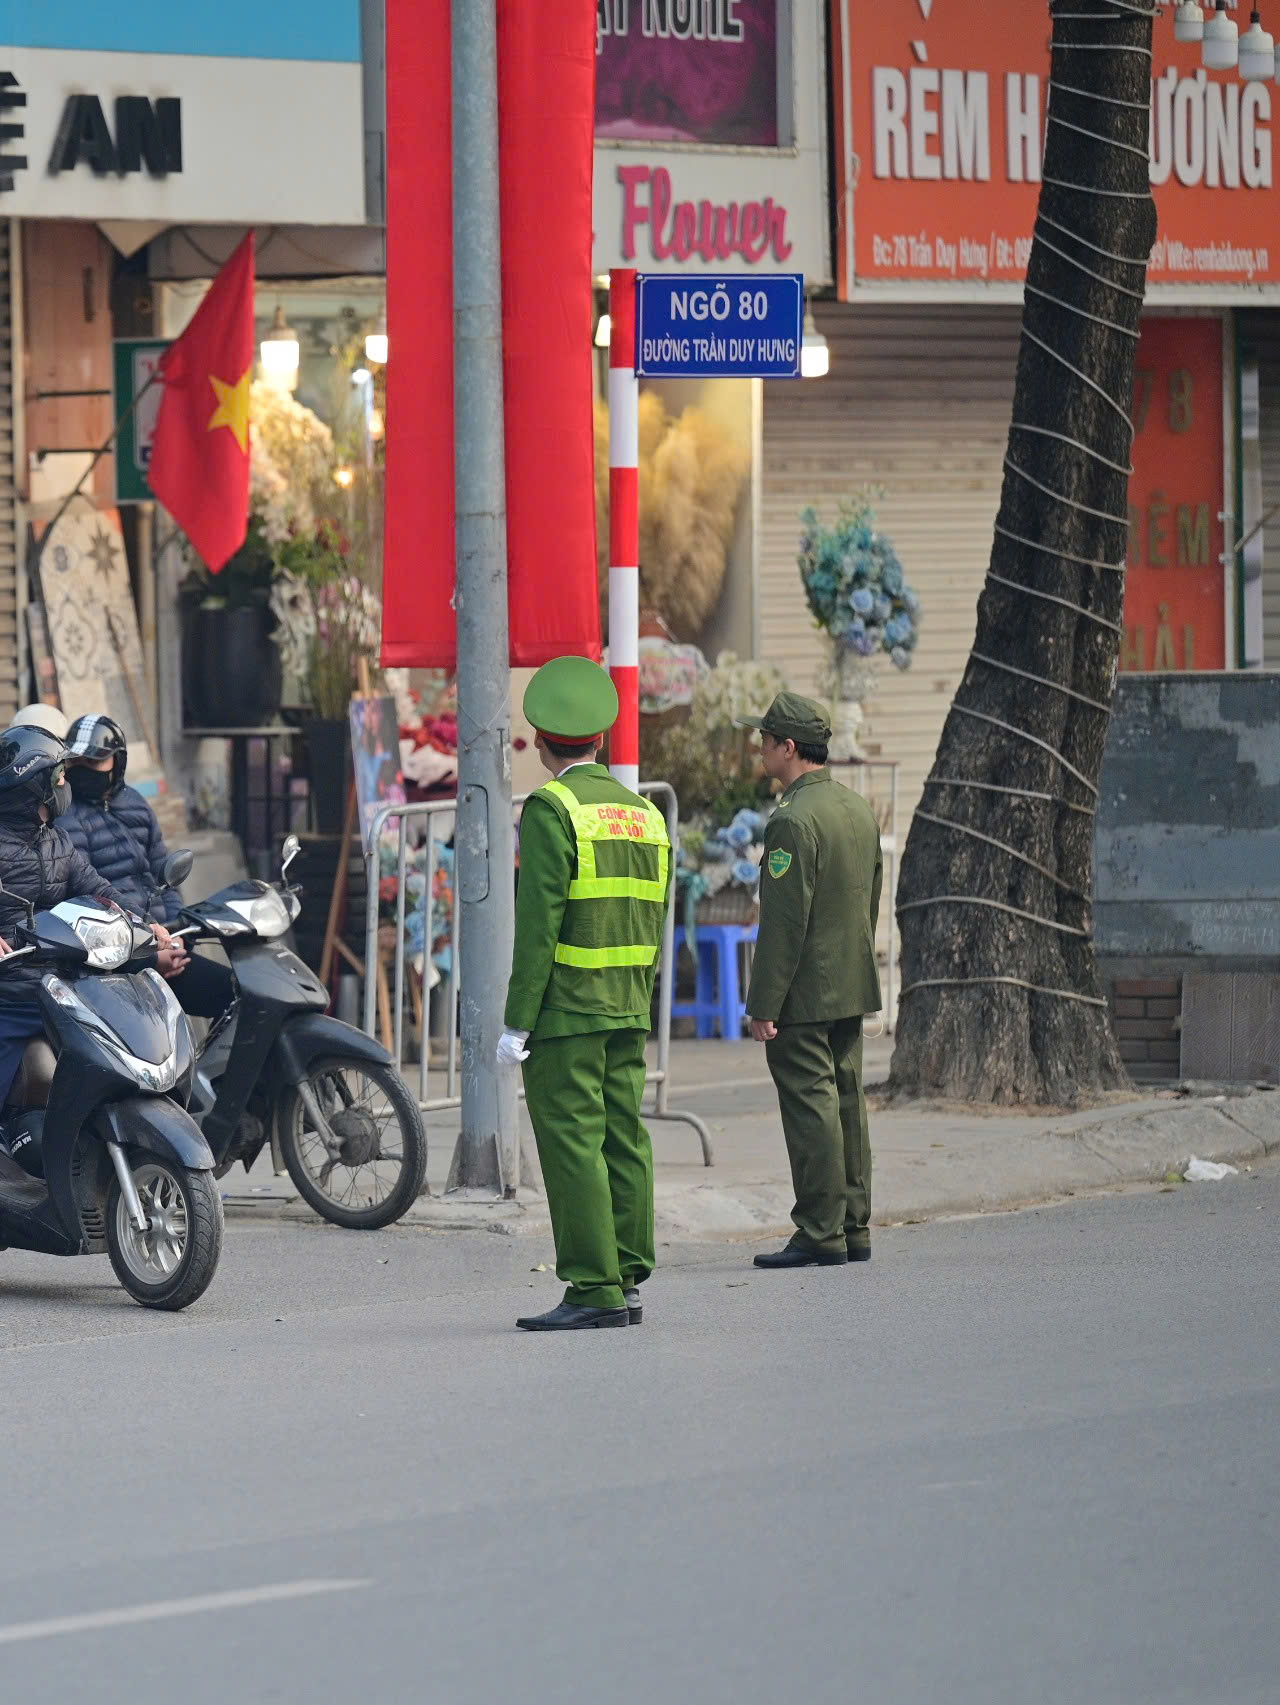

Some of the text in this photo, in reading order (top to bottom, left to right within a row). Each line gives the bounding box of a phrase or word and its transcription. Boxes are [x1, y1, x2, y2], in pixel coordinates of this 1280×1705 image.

[872, 40, 992, 183] RÈM
[46, 94, 183, 177] AN
[617, 164, 793, 263] Flower
[935, 235, 957, 276] Duy
[670, 283, 768, 321] NGÕ 80
[643, 332, 795, 362] ĐƯỜNG TRẦN DUY HƯNG
[13, 754, 42, 776] Vespa
[597, 804, 646, 824] CÔNG AN
